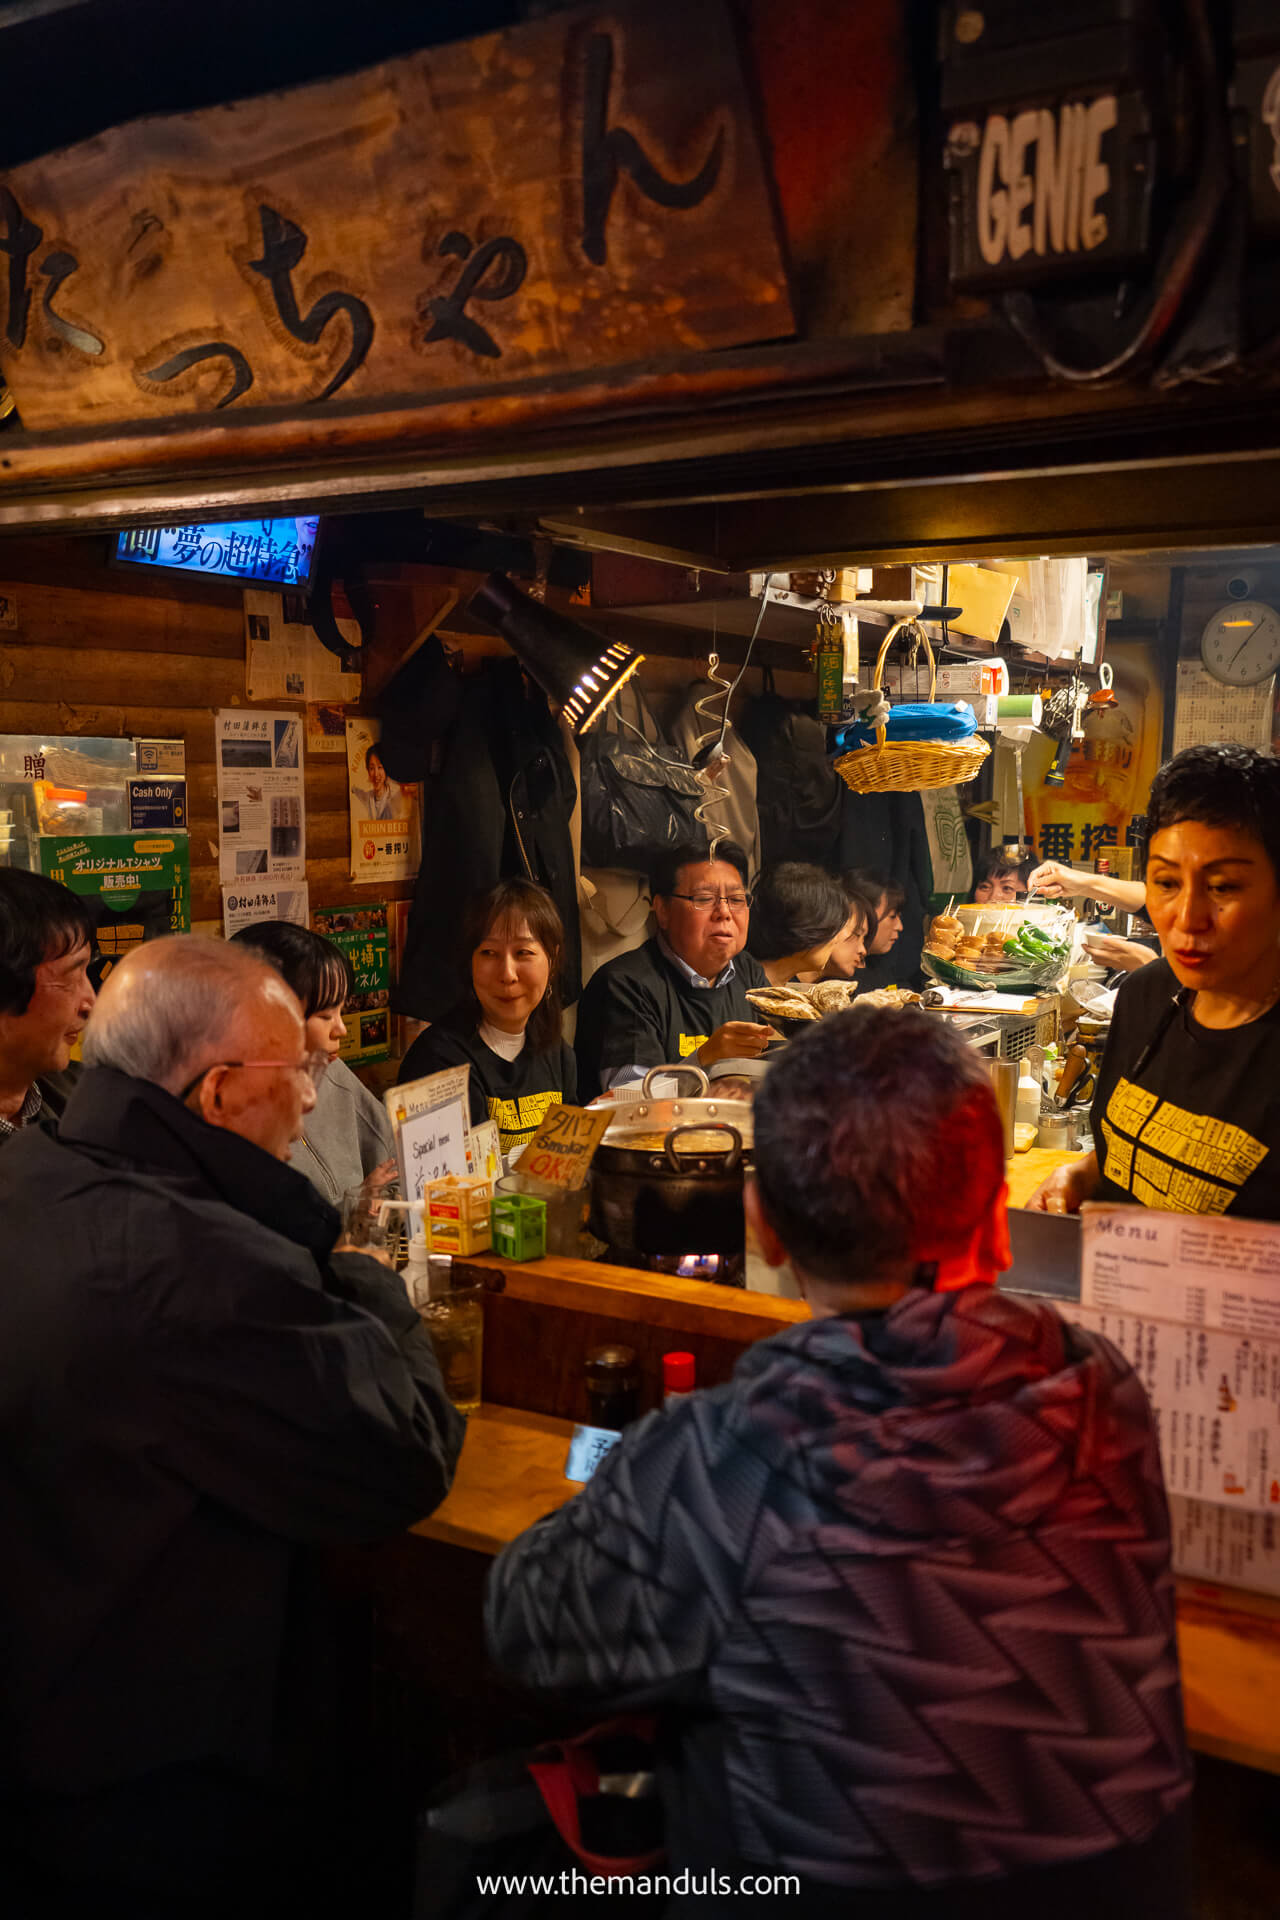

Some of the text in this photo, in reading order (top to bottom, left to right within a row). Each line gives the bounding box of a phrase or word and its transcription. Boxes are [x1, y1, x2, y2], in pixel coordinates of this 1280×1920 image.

[23, 752, 46, 781] 贈
[132, 786, 173, 800] Cash Only
[362, 822, 408, 835] KIRIN BEER
[75, 856, 162, 872] オリジナルTシャツ
